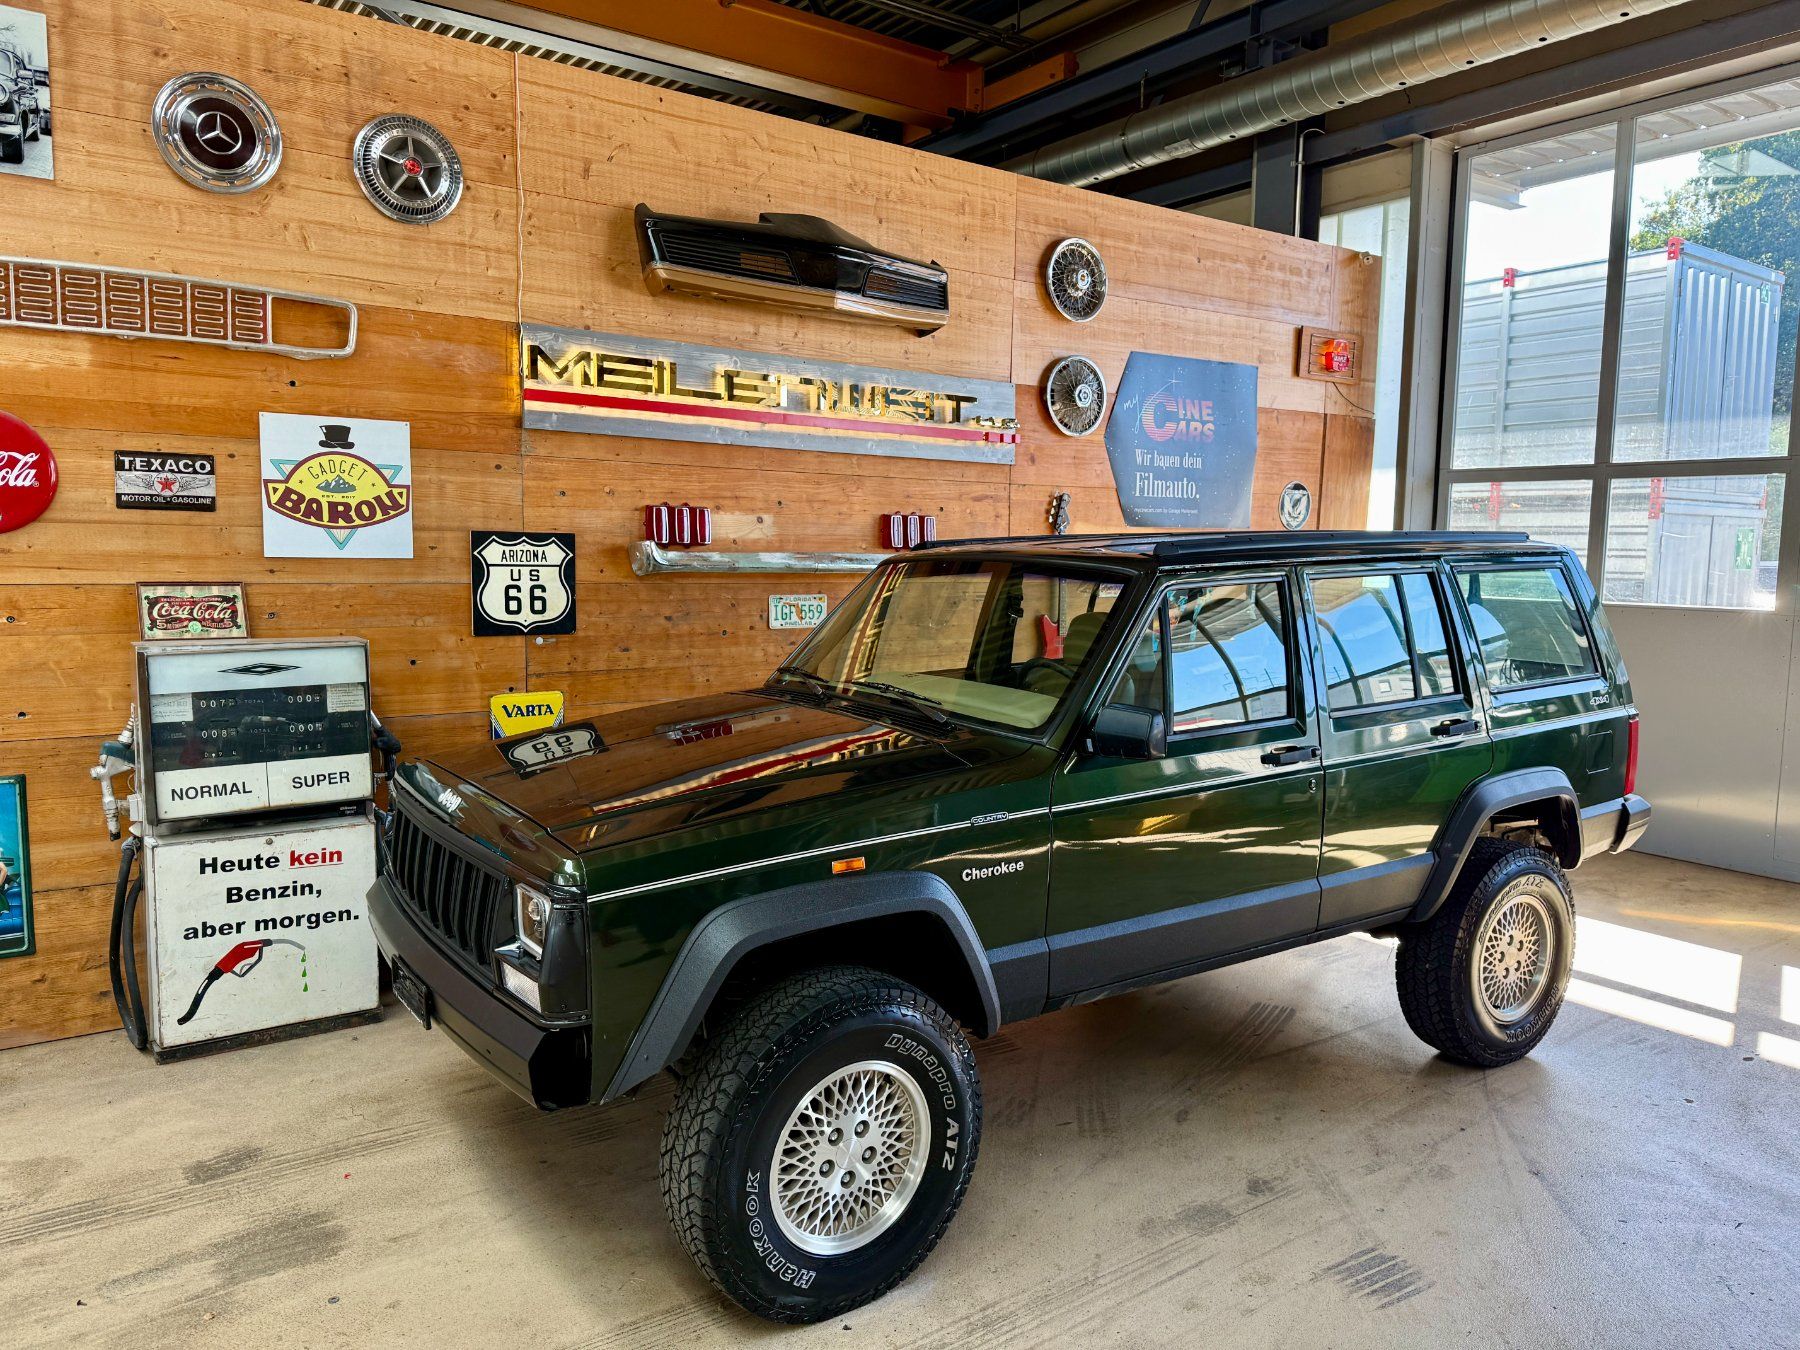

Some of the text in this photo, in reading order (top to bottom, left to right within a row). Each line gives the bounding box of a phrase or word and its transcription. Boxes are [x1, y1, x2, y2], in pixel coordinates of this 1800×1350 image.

[119, 457, 211, 473] TEXACO
[307, 459, 368, 481] GADGET
[1135, 449, 1202, 469] Wir bauen dein
[1134, 471, 1200, 499] Filmauto.
[121, 494, 151, 502] MOTOR
[171, 496, 212, 505] GASOLINE
[273, 485, 405, 524] BARON
[500, 549, 548, 563] ARIZONA
[504, 584, 547, 615] 66
[501, 704, 554, 718] VARTA
[291, 771, 351, 789] SUPER
[171, 781, 253, 802] NORMAL
[437, 788, 462, 814] Jeep
[972, 813, 1007, 824] COUNTRY
[199, 848, 343, 875] Heute kein
[961, 860, 1025, 882] Cherokee
[226, 880, 322, 904] Benzin,
[183, 906, 360, 941] aber morgen.
[884, 1033, 957, 1111] Dynapro
